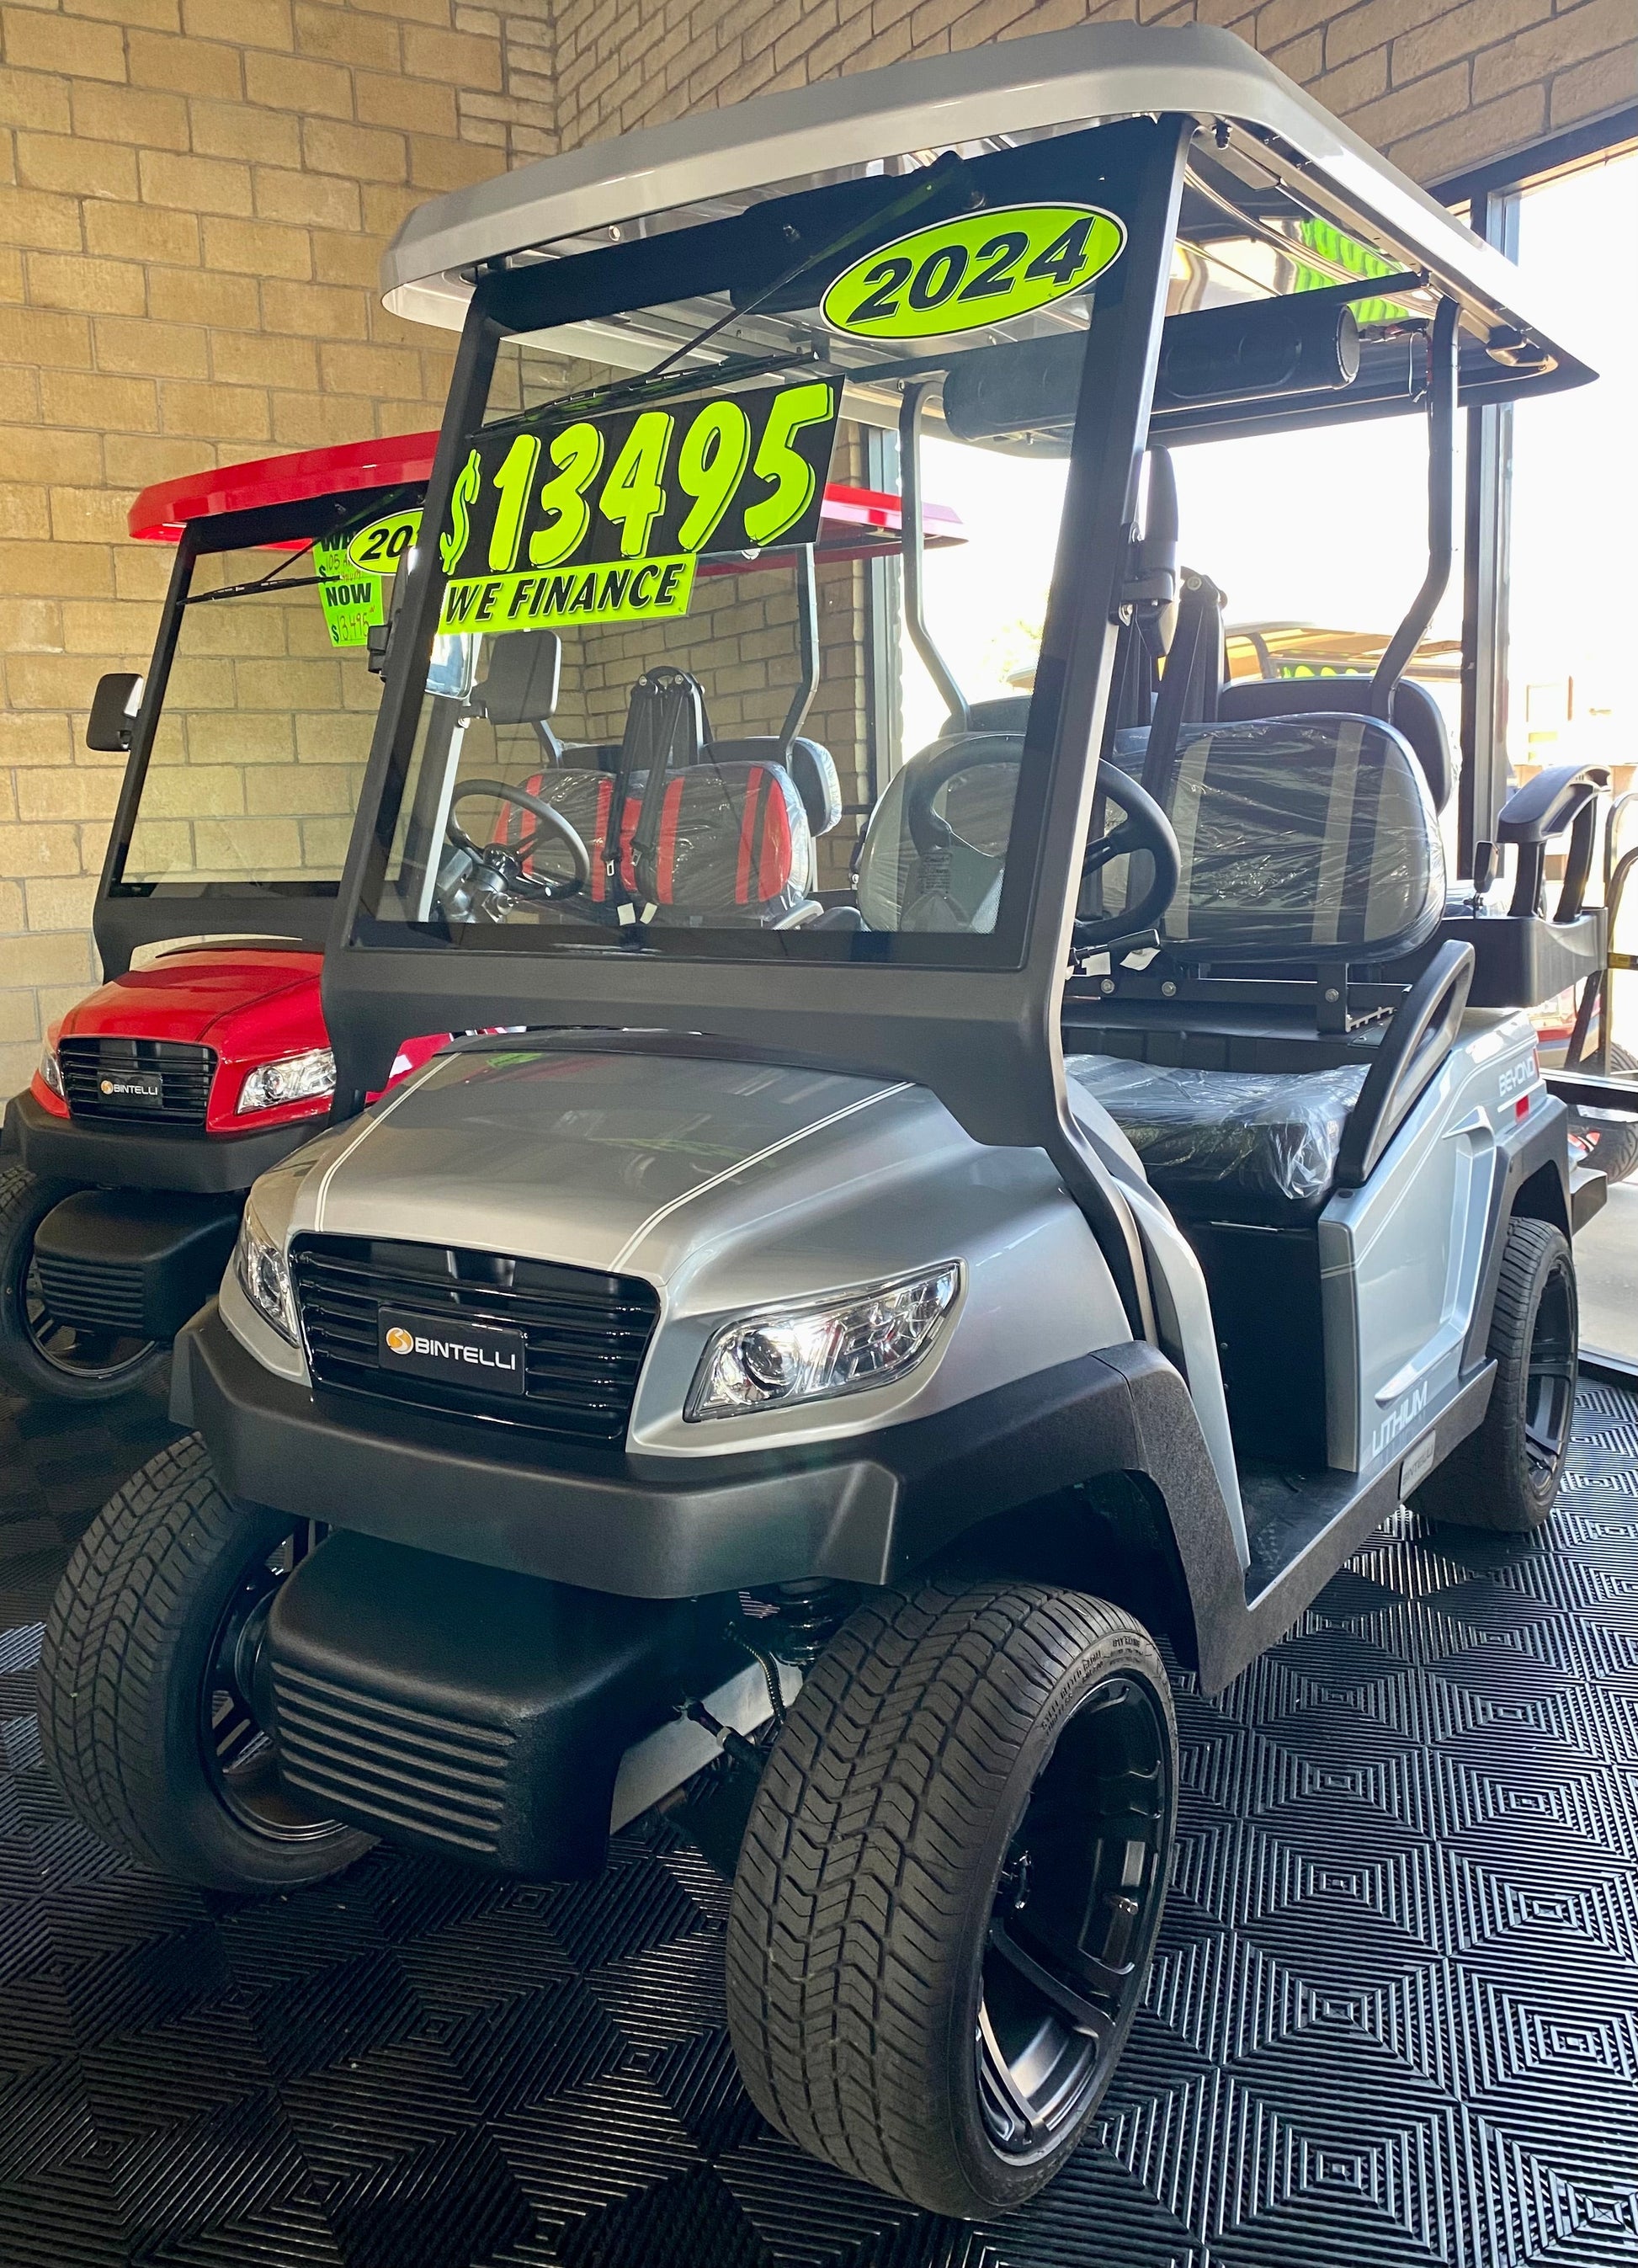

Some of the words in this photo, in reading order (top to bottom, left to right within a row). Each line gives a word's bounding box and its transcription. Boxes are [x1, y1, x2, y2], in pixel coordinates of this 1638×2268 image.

[845, 216, 1097, 327] 2024
[439, 382, 834, 576] $13495
[359, 524, 421, 562] 20
[325, 582, 372, 607] NOW
[445, 580, 503, 625] WE
[507, 562, 686, 620] FINANCE
[114, 1083, 158, 1096] BINTELLI
[1498, 1055, 1535, 1097] BEYOND
[414, 1336, 516, 1371] BINTELLI
